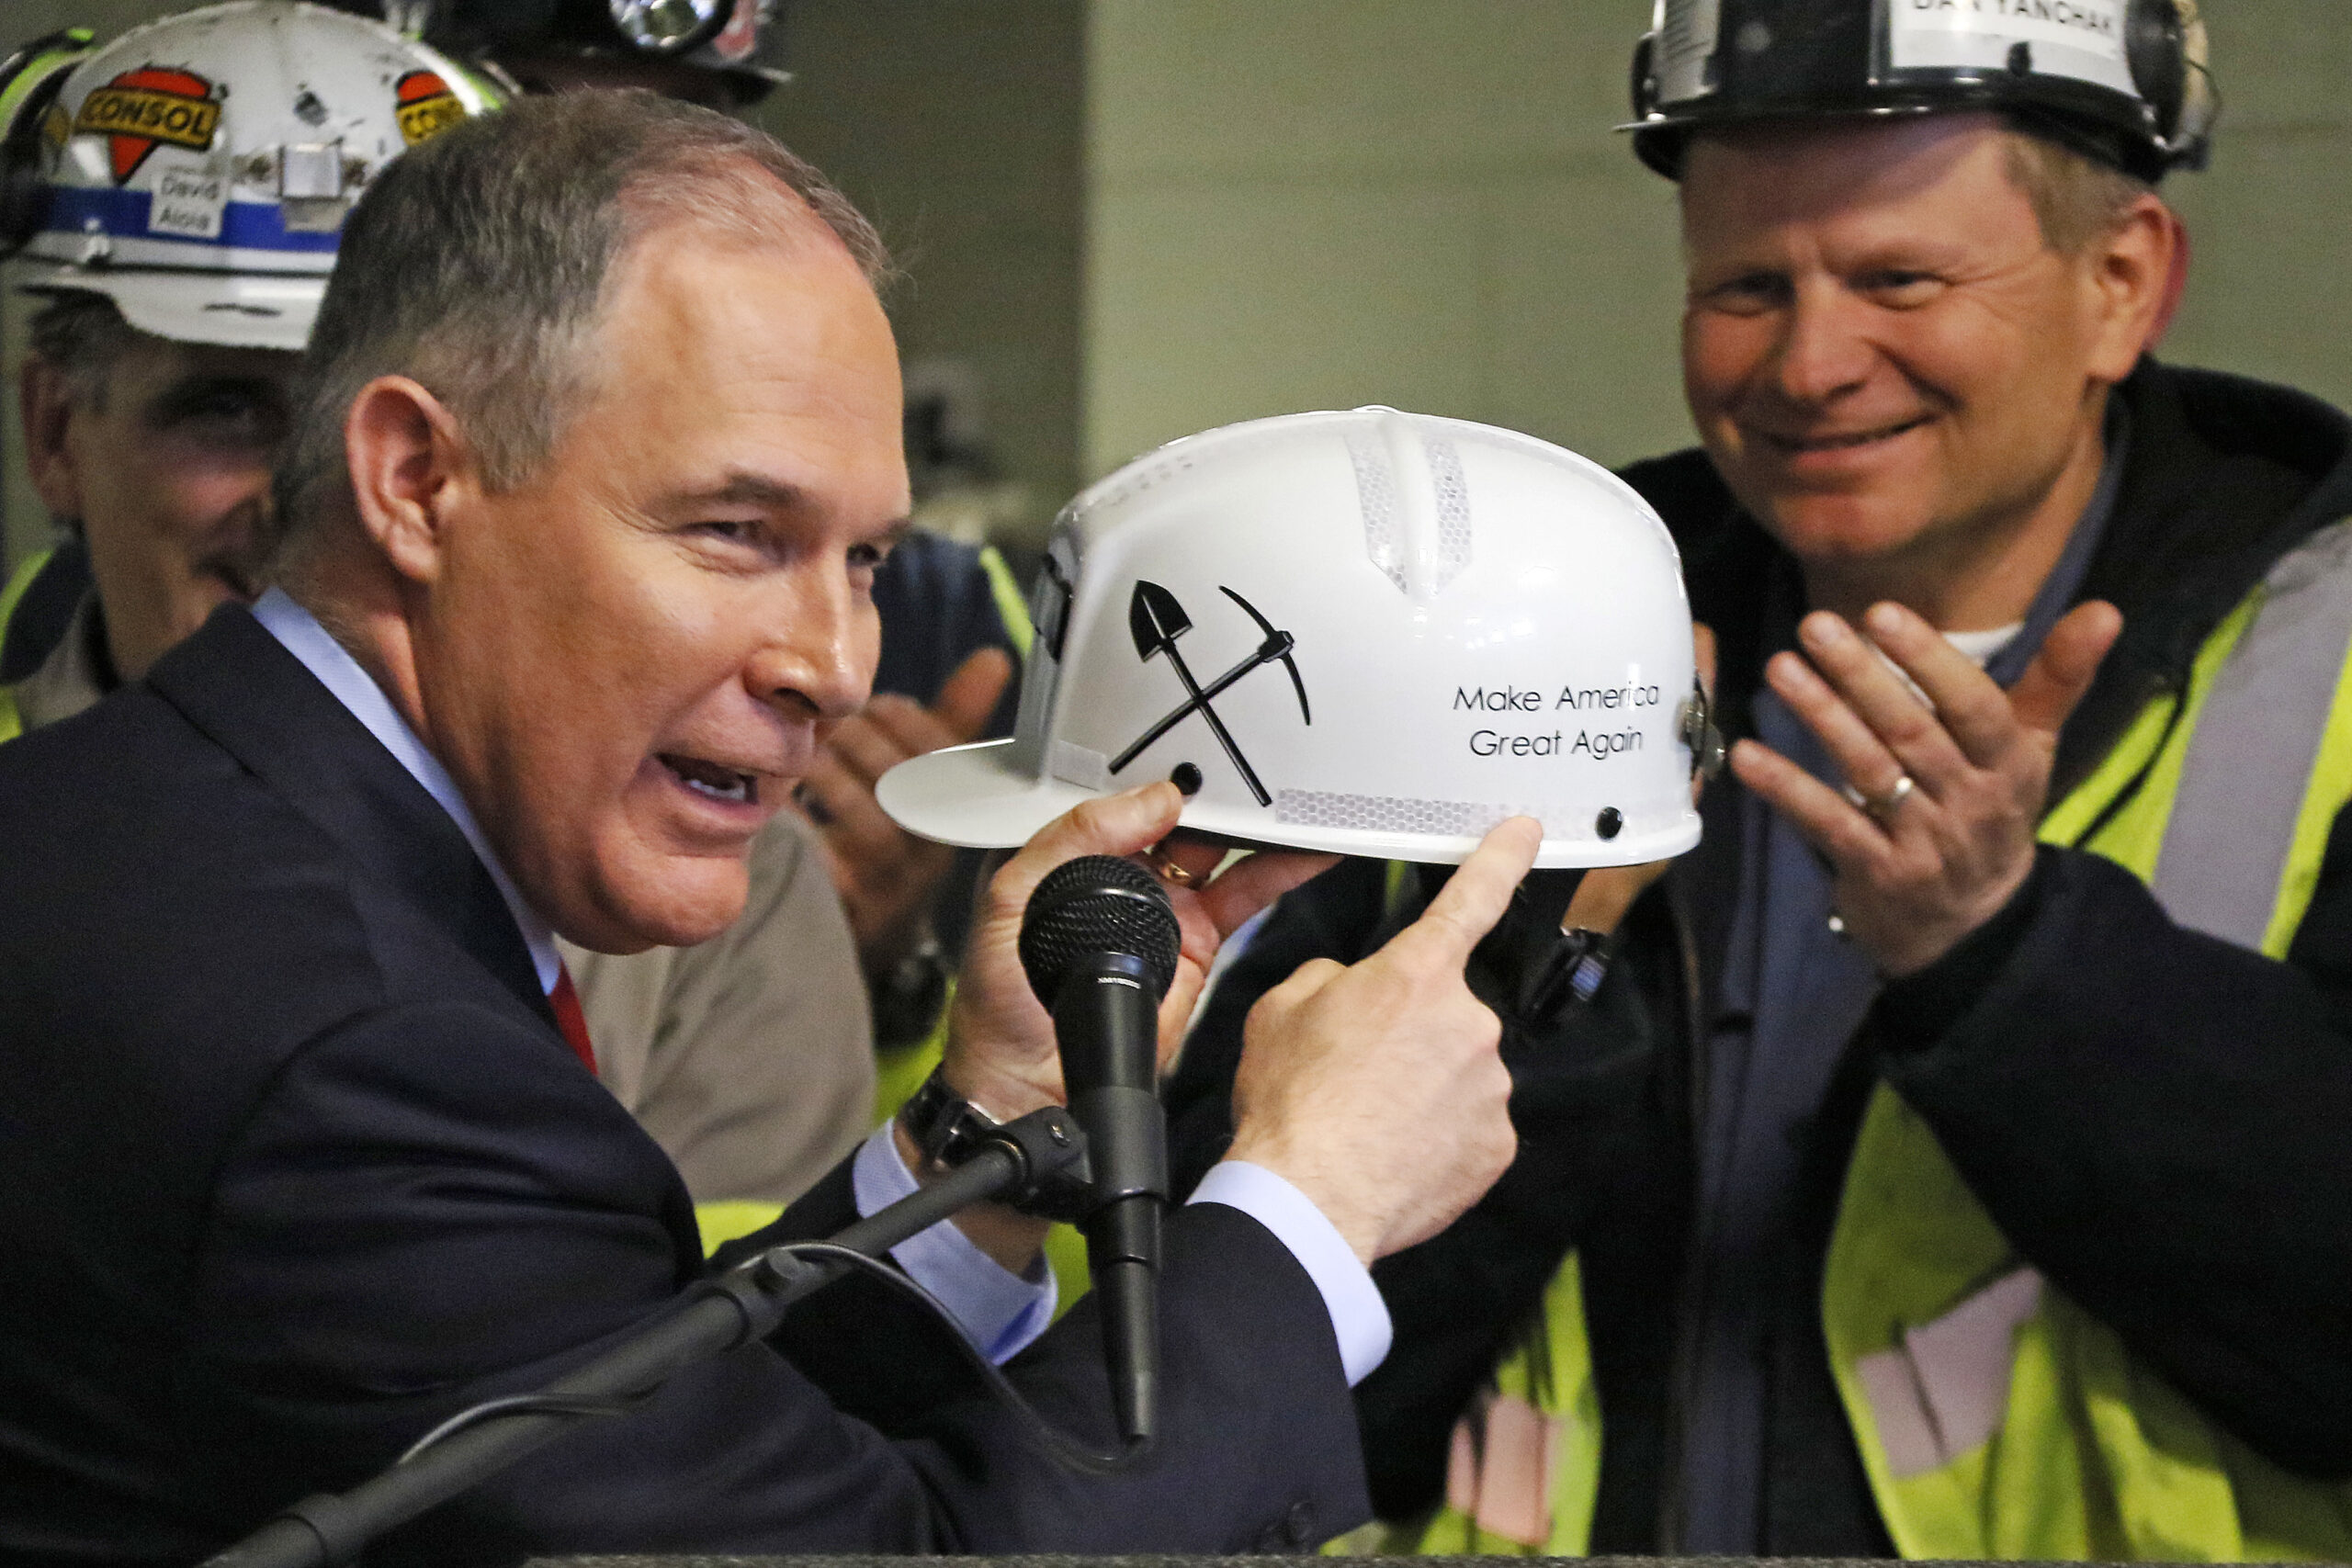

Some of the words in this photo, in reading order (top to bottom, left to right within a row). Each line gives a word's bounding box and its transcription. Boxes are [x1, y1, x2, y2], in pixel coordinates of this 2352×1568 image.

[85, 95, 206, 135] CONSOL
[1453, 684, 1542, 712] Make
[1555, 681, 1659, 709] America
[1469, 729, 1562, 756] Great
[1570, 726, 1643, 761] Again
